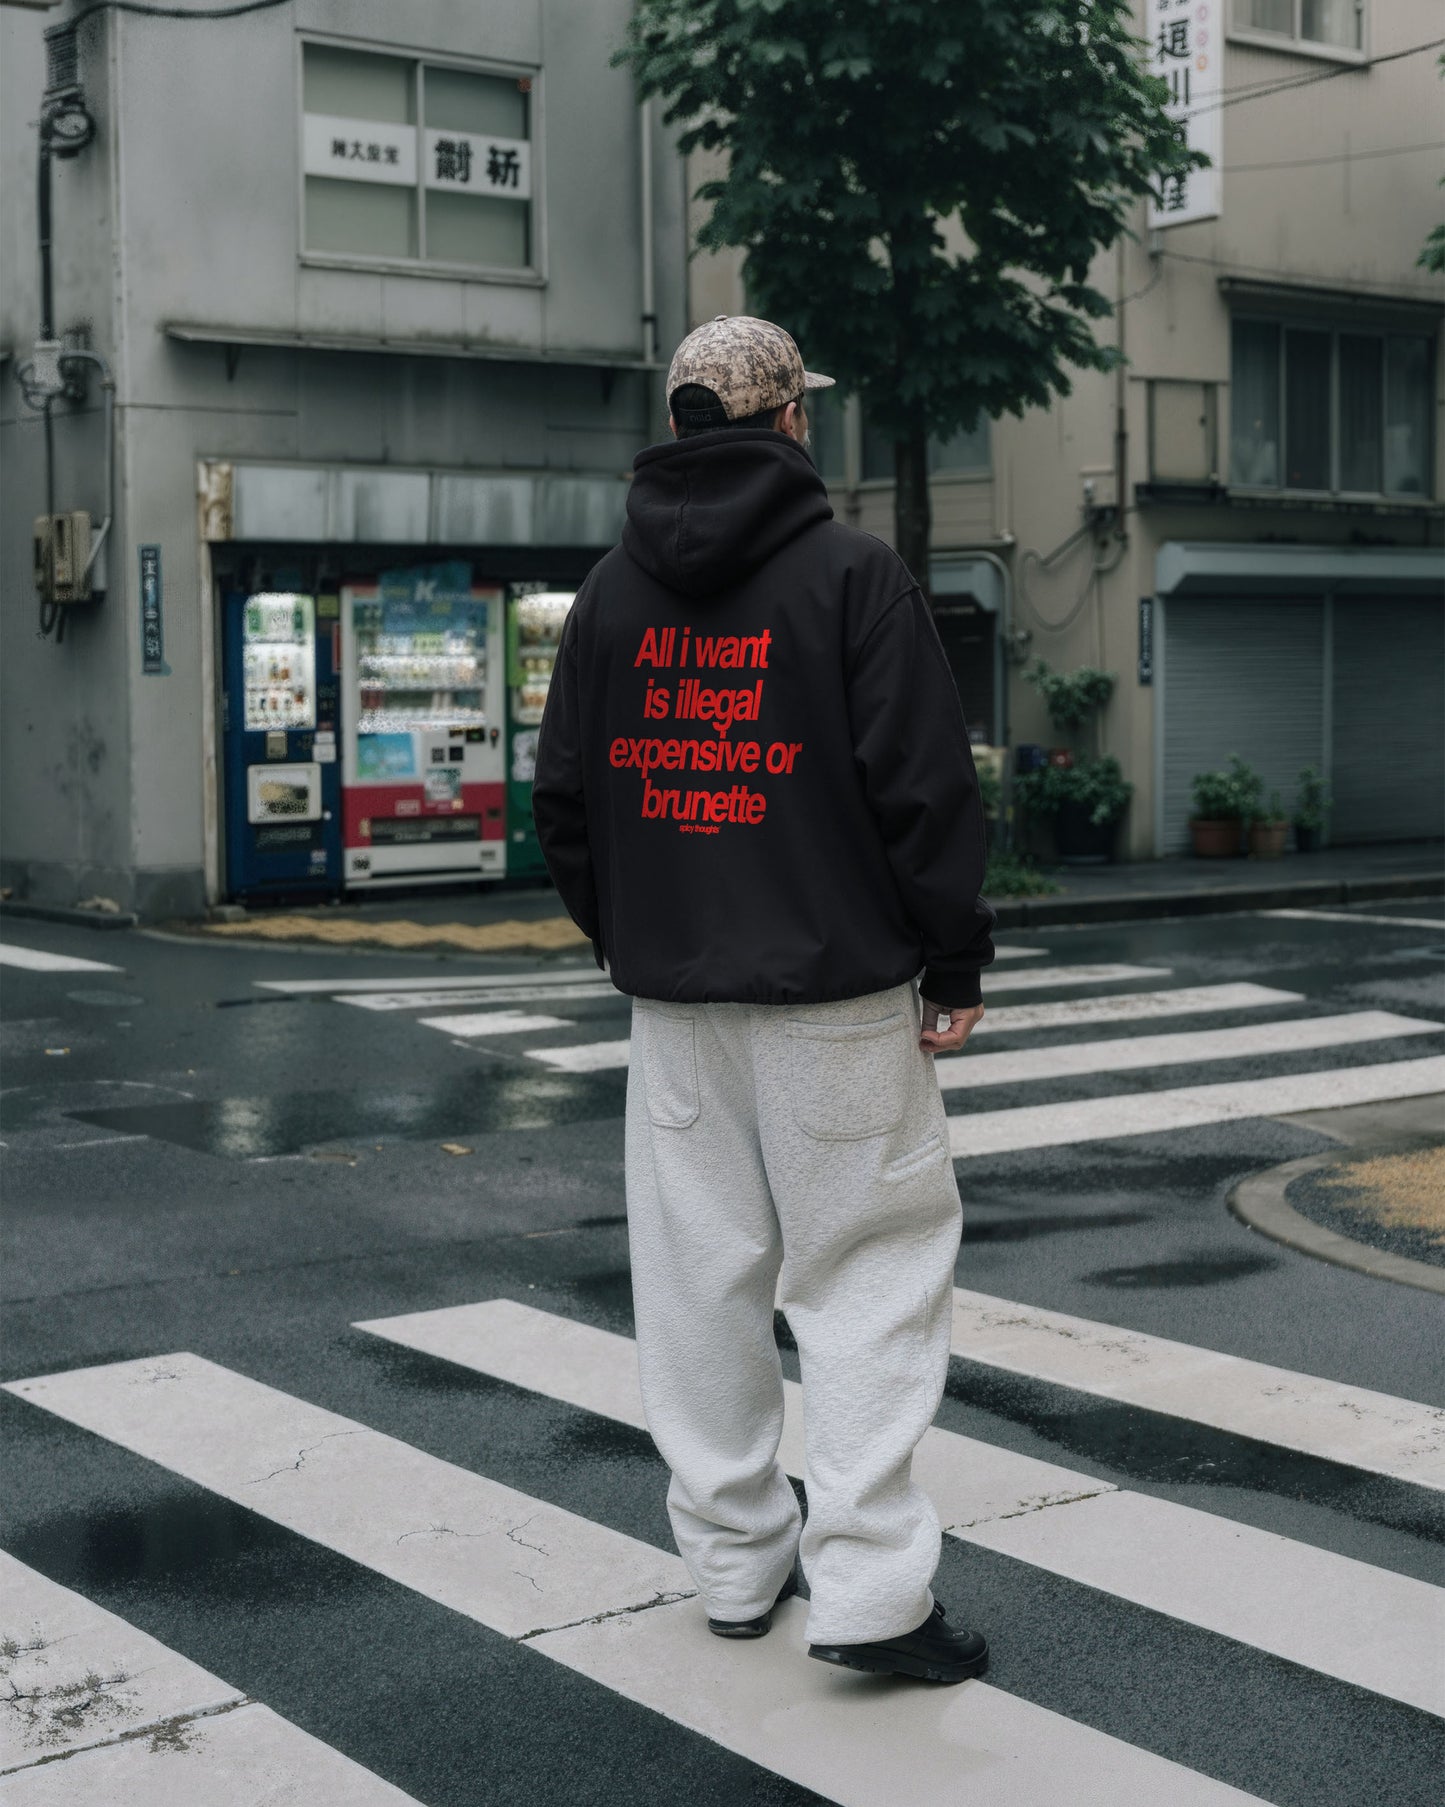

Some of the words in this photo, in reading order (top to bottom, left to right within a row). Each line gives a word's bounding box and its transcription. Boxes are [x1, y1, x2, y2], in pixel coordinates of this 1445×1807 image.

[634, 627, 676, 668] All
[679, 627, 691, 668] i
[695, 629, 772, 669] want
[643, 678, 671, 719] is
[675, 678, 764, 731] illegal
[609, 730, 761, 779] expensive
[765, 742, 803, 774] or
[641, 779, 767, 824] brunette
[679, 824, 694, 834] spicy
[695, 824, 720, 835] thoughts
